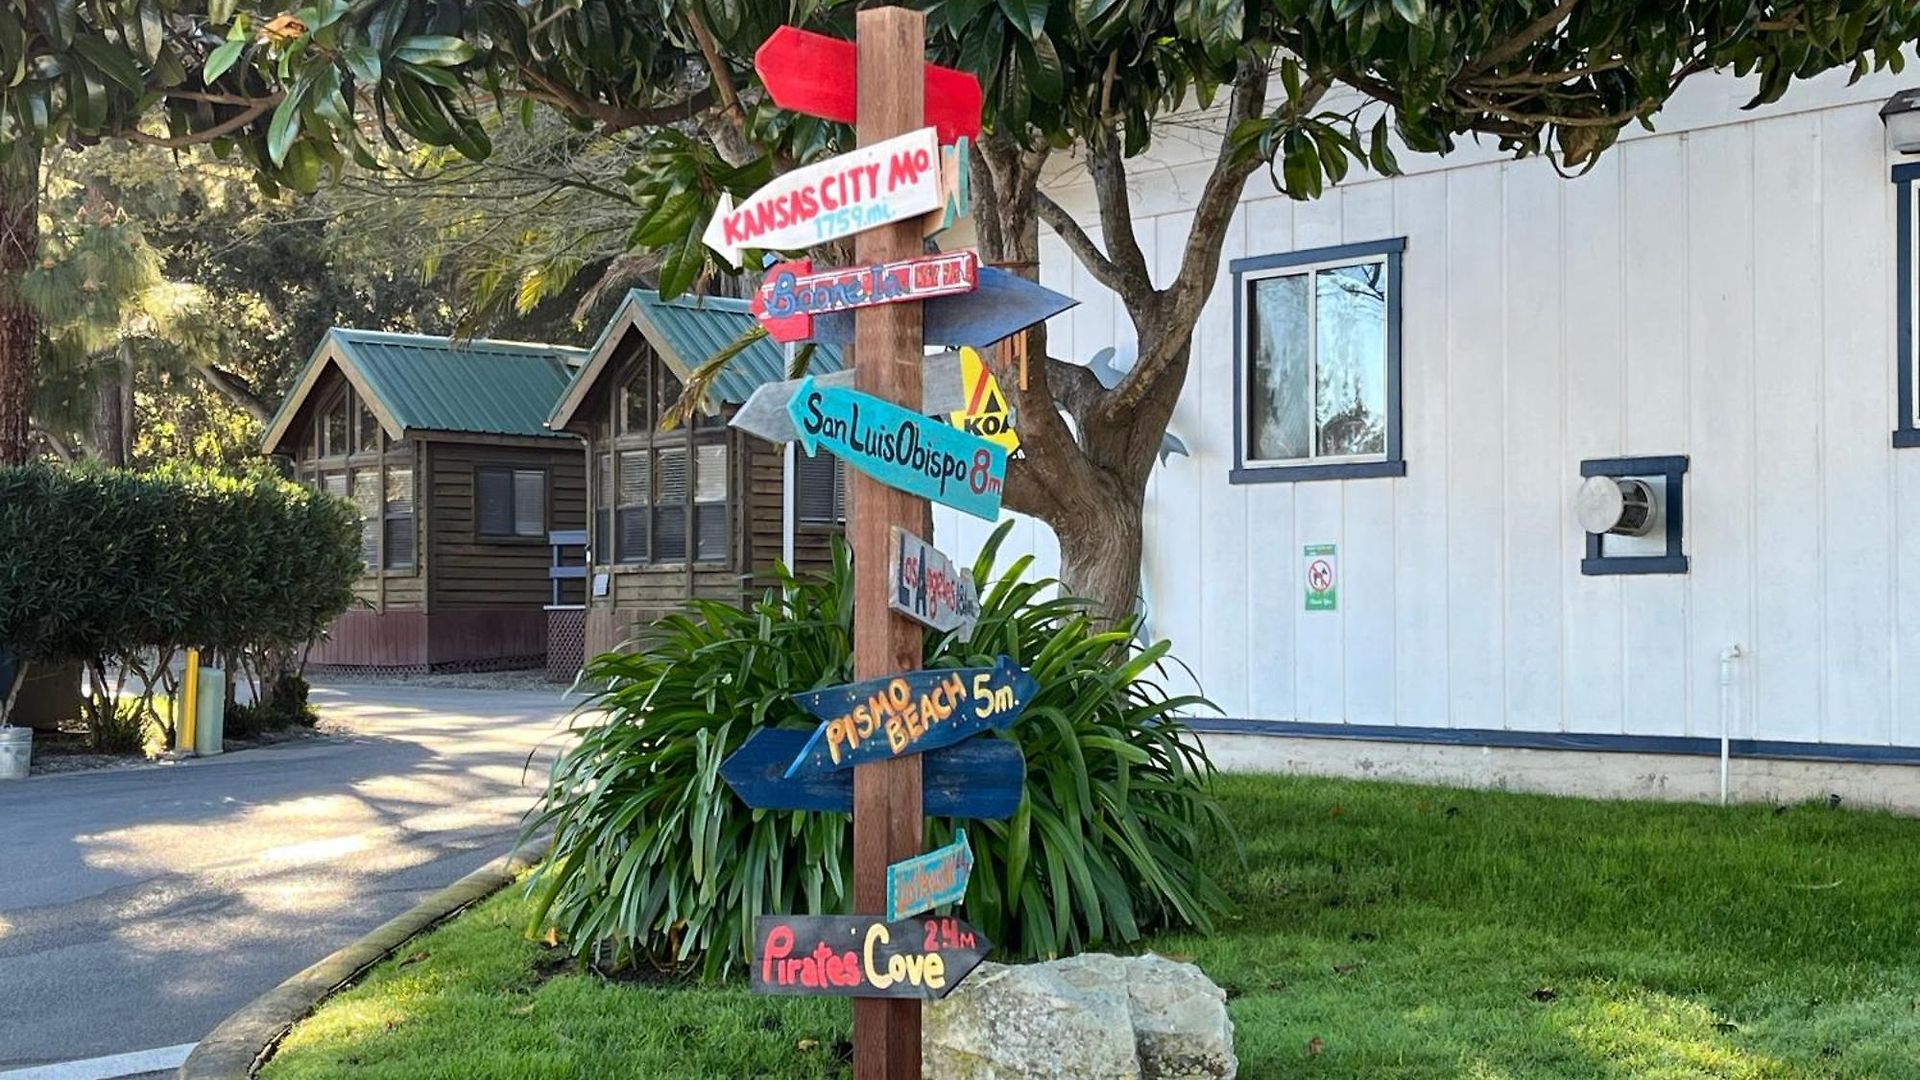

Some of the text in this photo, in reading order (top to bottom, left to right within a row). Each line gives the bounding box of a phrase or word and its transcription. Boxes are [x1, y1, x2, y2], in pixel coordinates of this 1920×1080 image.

[722, 186, 819, 245] KANSAS
[819, 162, 880, 211] CITY
[764, 272, 865, 318] Boone
[803, 392, 846, 444] San
[851, 402, 894, 463] Luis
[896, 421, 967, 496] Obispo
[826, 678, 911, 765] PISMO
[885, 671, 967, 754] BEACH
[762, 924, 862, 989] Pirates
[864, 922, 946, 989] Cove
